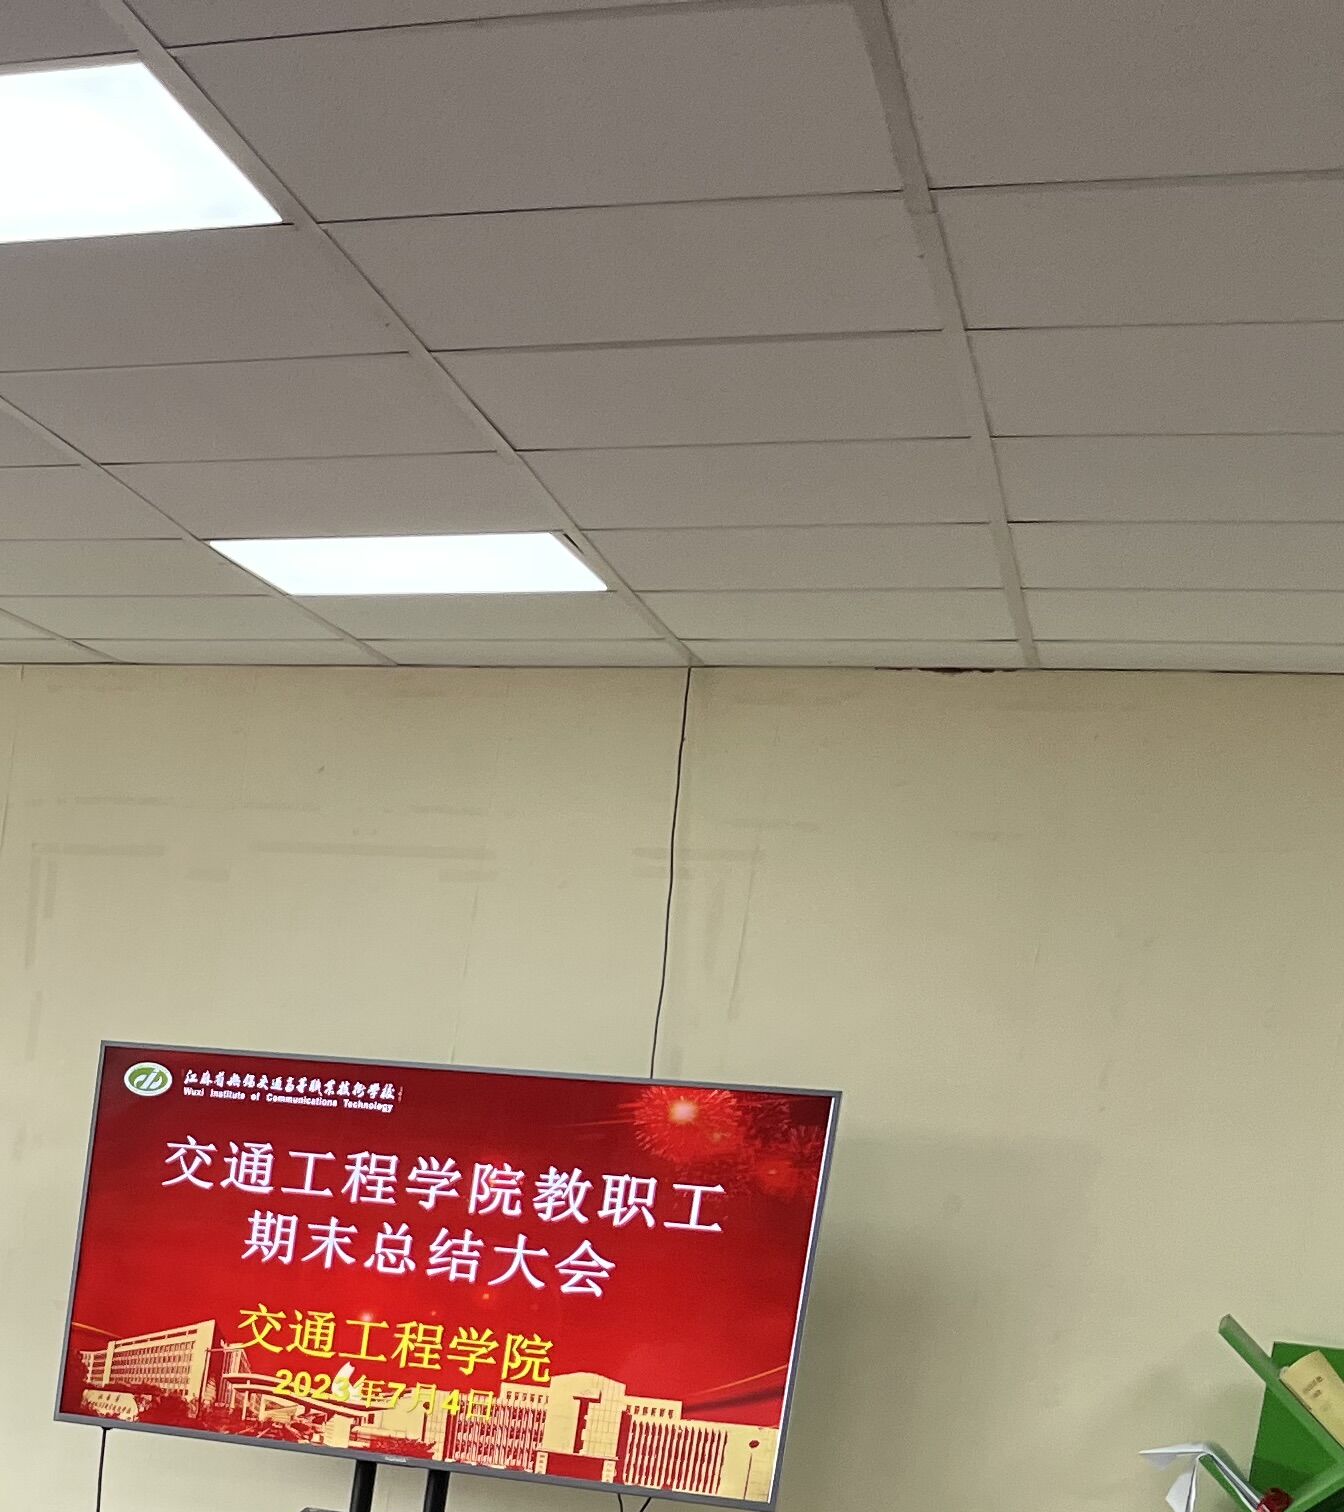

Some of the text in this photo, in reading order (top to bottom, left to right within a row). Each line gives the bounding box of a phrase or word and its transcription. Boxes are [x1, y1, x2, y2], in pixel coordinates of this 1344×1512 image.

[183, 1087, 394, 1113] Wuxi Institute of Communications Technology
[161, 1135, 727, 1234] 交通工程学院教职工
[240, 1210, 617, 1298] 期末总结大会
[238, 1303, 555, 1383] 交通工程学院
